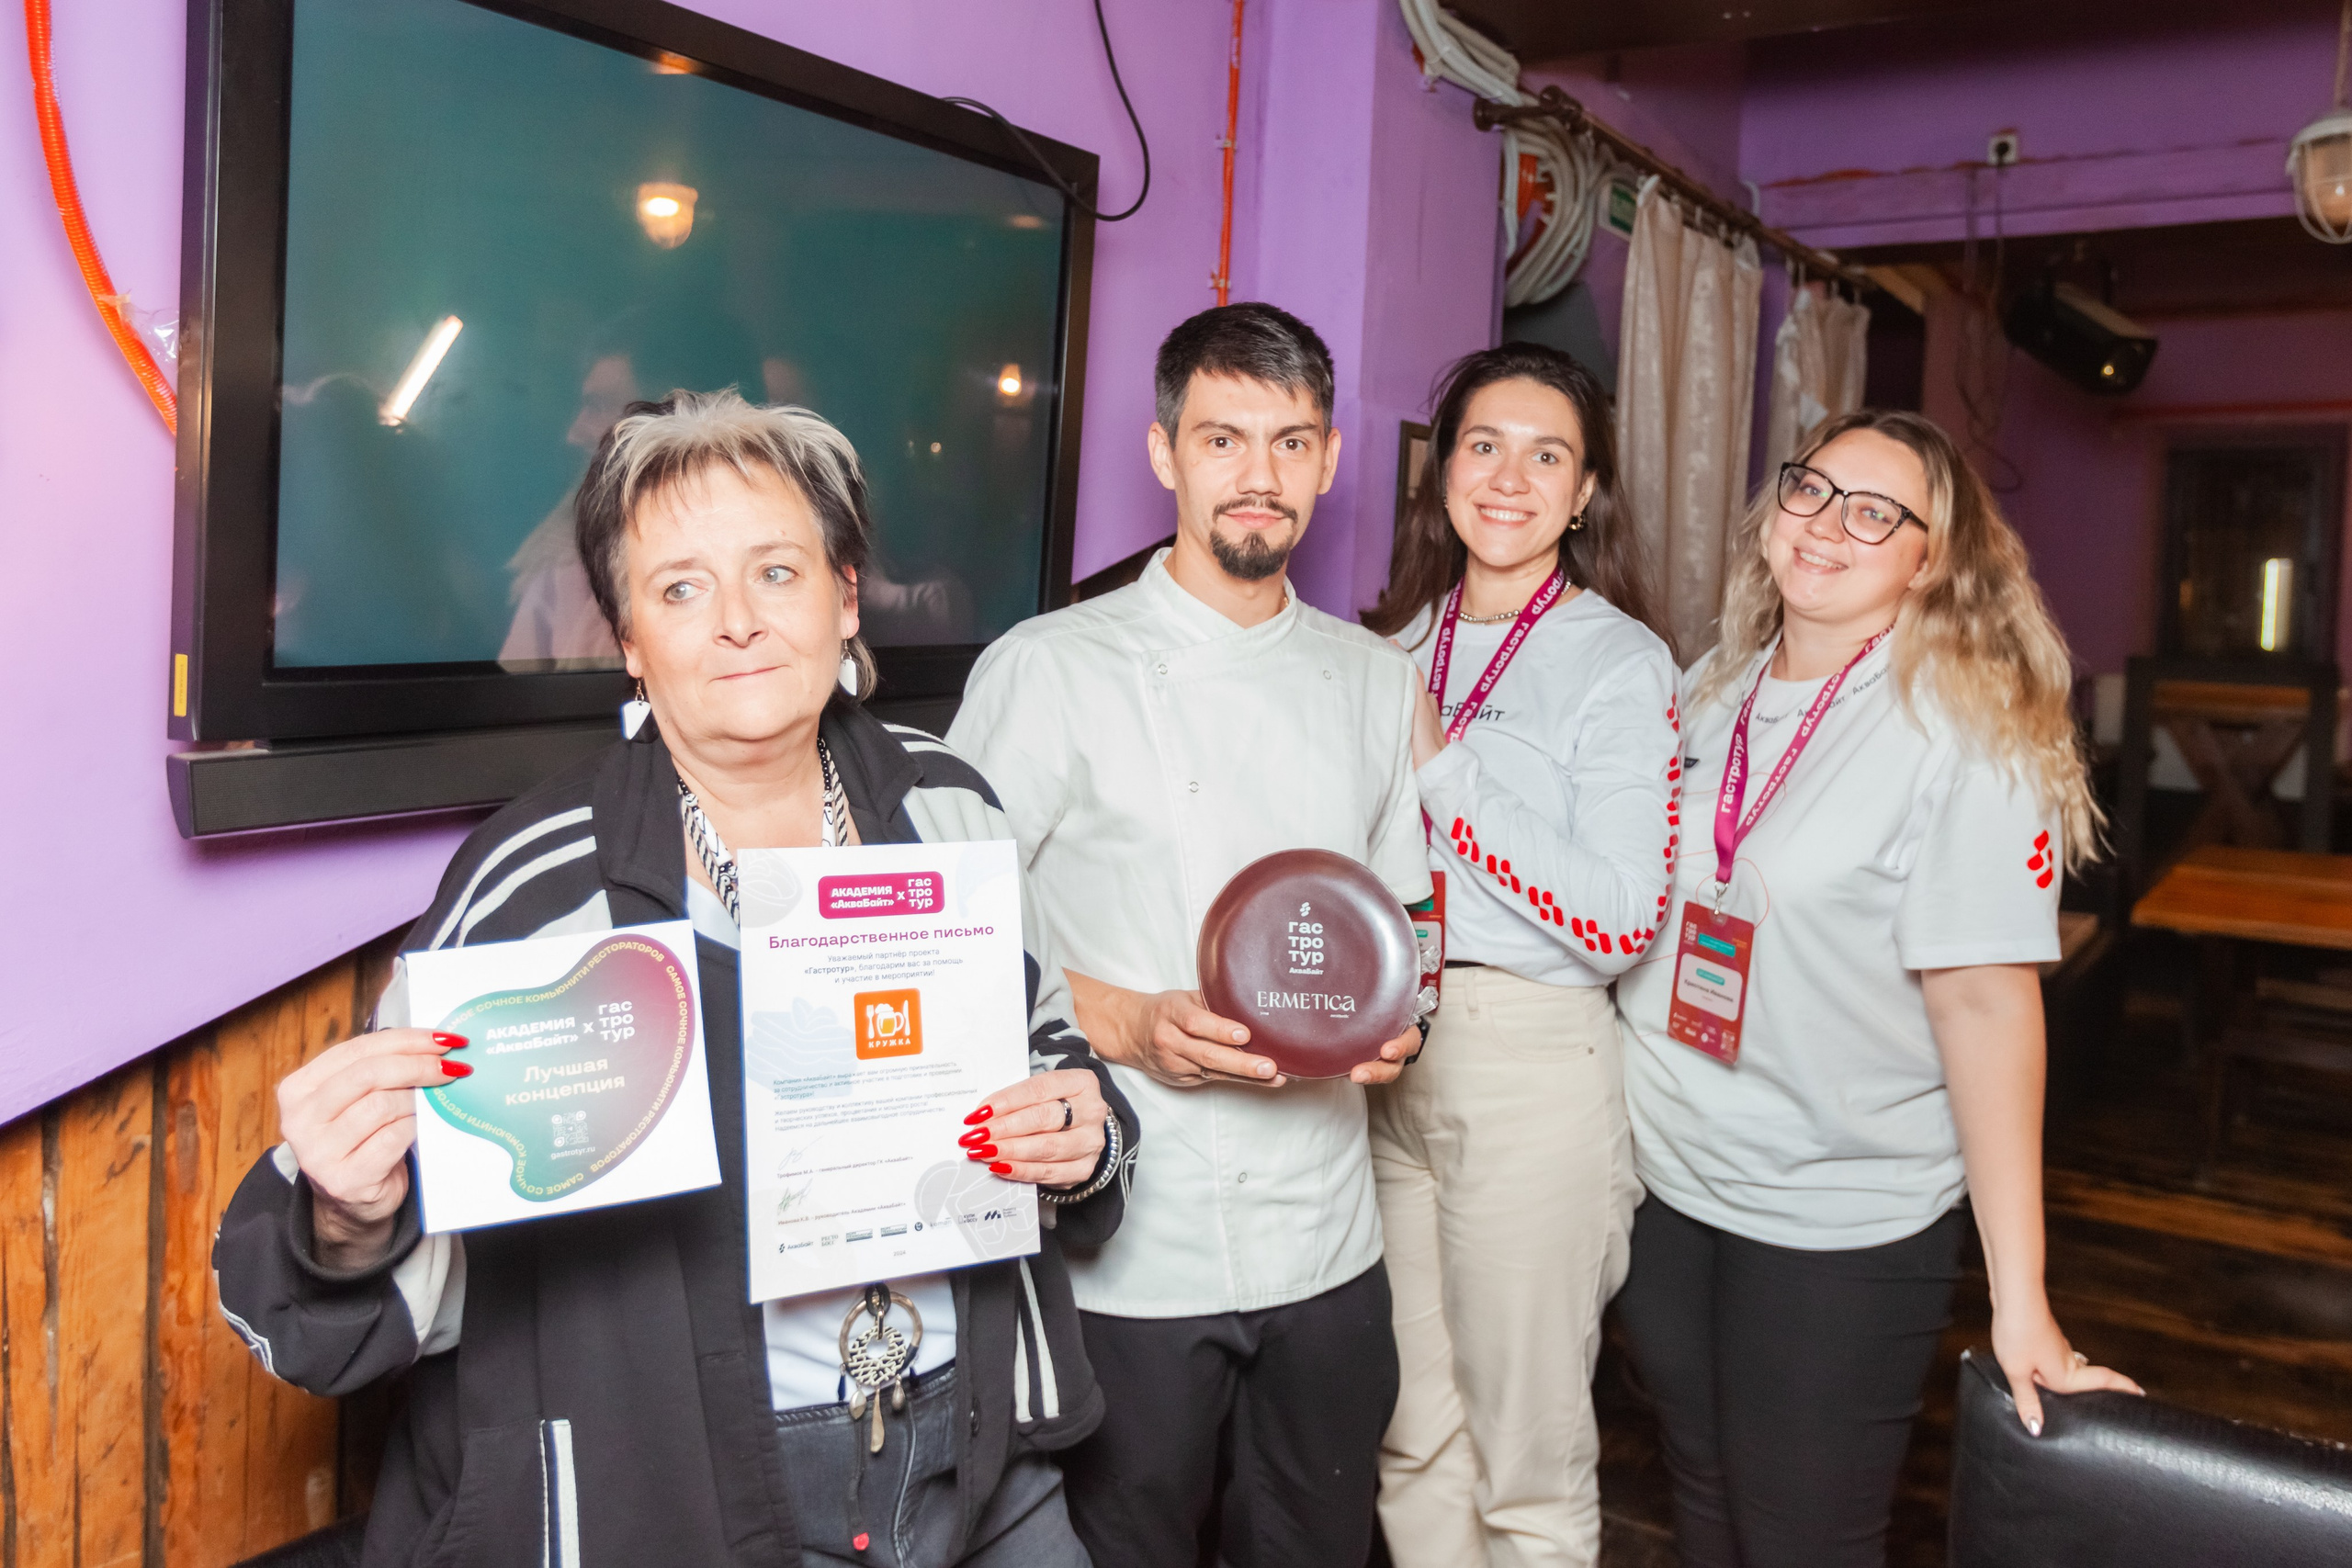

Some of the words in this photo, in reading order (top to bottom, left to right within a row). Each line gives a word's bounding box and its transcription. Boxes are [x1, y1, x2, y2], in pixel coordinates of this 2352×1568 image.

[1480, 622, 1529, 693] гастротур
[1721, 732, 1743, 814] гастротур
[1746, 748, 1797, 827] гастротур
[831, 885, 893, 897] АКАДЕМИЯ
[908, 877, 933, 887] гас
[908, 887, 933, 897] тро
[831, 897, 895, 909] «АкваБайт»
[909, 897, 933, 910] тур
[769, 930, 929, 949] Благодарственное
[933, 925, 995, 939] письмо
[1288, 921, 1323, 934] гас
[1288, 936, 1324, 951] тро
[828, 952, 874, 964] Уважаемый
[875, 949, 908, 960] партнёр
[909, 948, 941, 958] проекта
[1288, 950, 1325, 966] тур
[804, 964, 857, 976] «Гастротур»,
[858, 961, 906, 972] благодарим
[933, 957, 964, 966] помощь
[446, 1009, 474, 1032] АМОЕ
[475, 995, 524, 1013] СОЧНОЕ
[525, 965, 590, 1004] КОМЬЮНИТИ
[587, 941, 665, 969] РЕСТОРАТОРОВ
[665, 965, 686, 1000] САМОЕ
[842, 975, 873, 986] участие
[881, 969, 935, 980] мероприятии!
[598, 1000, 633, 1015] гас
[486, 1016, 576, 1041] АКАДЕМИЯ
[599, 1013, 634, 1029] тро
[677, 1000, 688, 1044] СОЧНОЕ
[485, 1033, 579, 1055] «АкваБайт»
[600, 1026, 636, 1043] тур
[868, 1038, 911, 1049] КРУЖКА
[524, 1058, 608, 1084] Лучшая
[651, 1045, 684, 1112] КОМЬЮНИТИ
[505, 1076, 626, 1106] концепция
[781, 1083, 828, 1092] сотрудничество
[466, 1114, 527, 1158] КОМЬЮНИТИ
[590, 1110, 656, 1173] РЕСТОРАТОРОВ
[550, 1145, 596, 1160] gastrotyr.ru
[515, 1159, 544, 1195] СОЧНОЕ
[546, 1172, 584, 1195] САМОЕ
